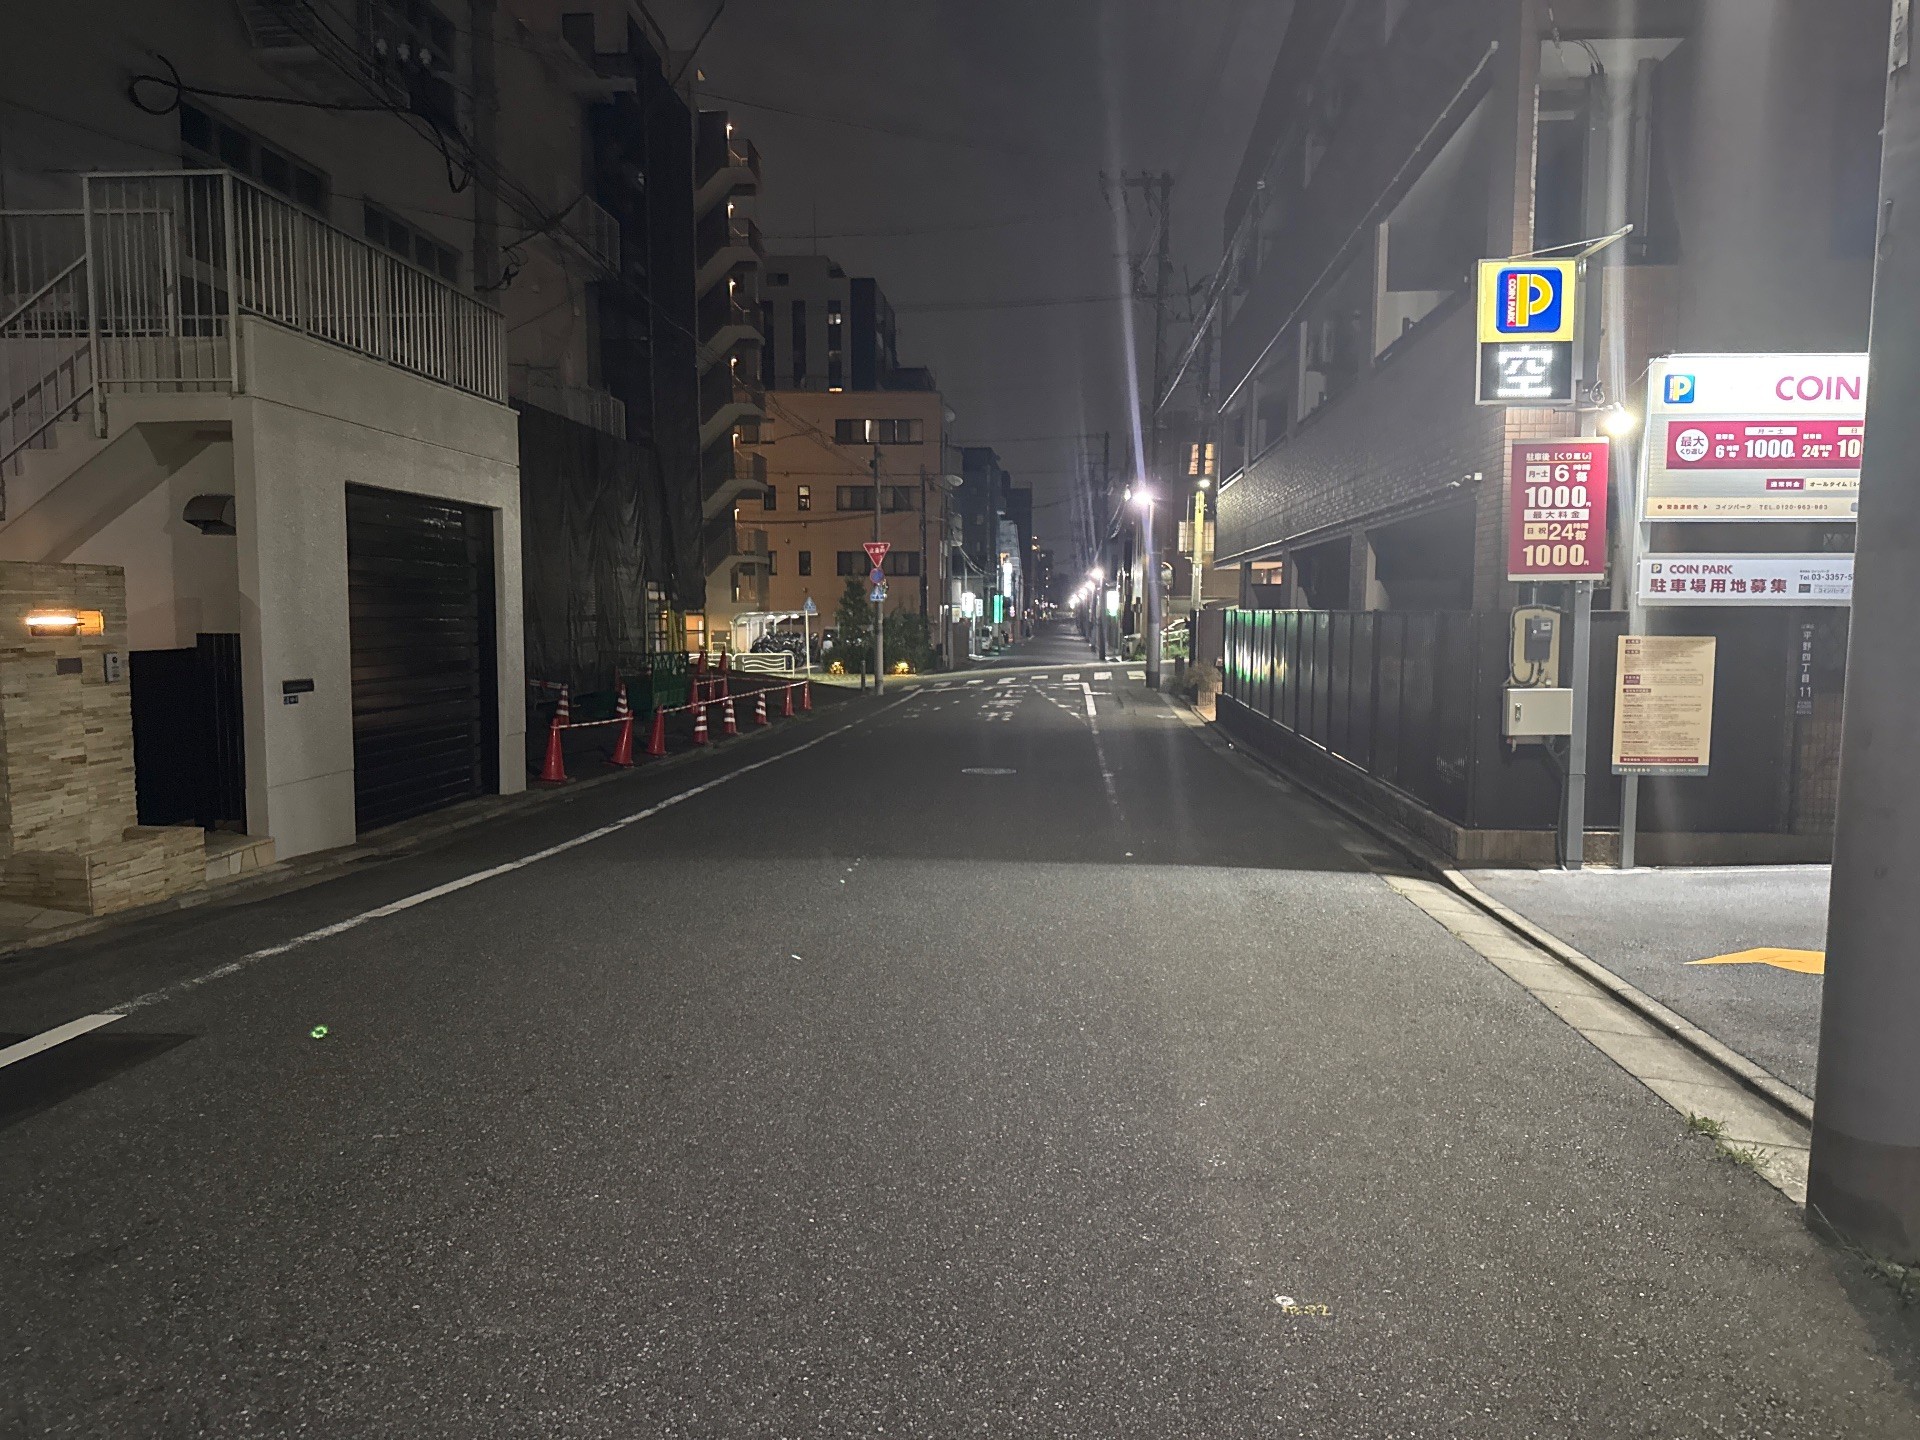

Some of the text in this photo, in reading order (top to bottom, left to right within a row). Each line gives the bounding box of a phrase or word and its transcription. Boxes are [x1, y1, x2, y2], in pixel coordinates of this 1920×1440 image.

[1507, 278, 1517, 323] COIN PARK
[1498, 345, 1553, 397] 空
[1775, 376, 1861, 401] COIN
[1681, 436, 1704, 447] 最大
[1715, 444, 1725, 458] 6
[1802, 444, 1820, 458] 24
[1554, 464, 1570, 482] 6
[1533, 511, 1580, 519] 最大料金
[1548, 523, 1574, 540] 24
[1669, 565, 1733, 574] COIN PARK
[1650, 578, 1787, 593] 駐車場用地募集
[1801, 631, 1812, 683] 平野四丁目
[1799, 686, 1812, 698] 11
